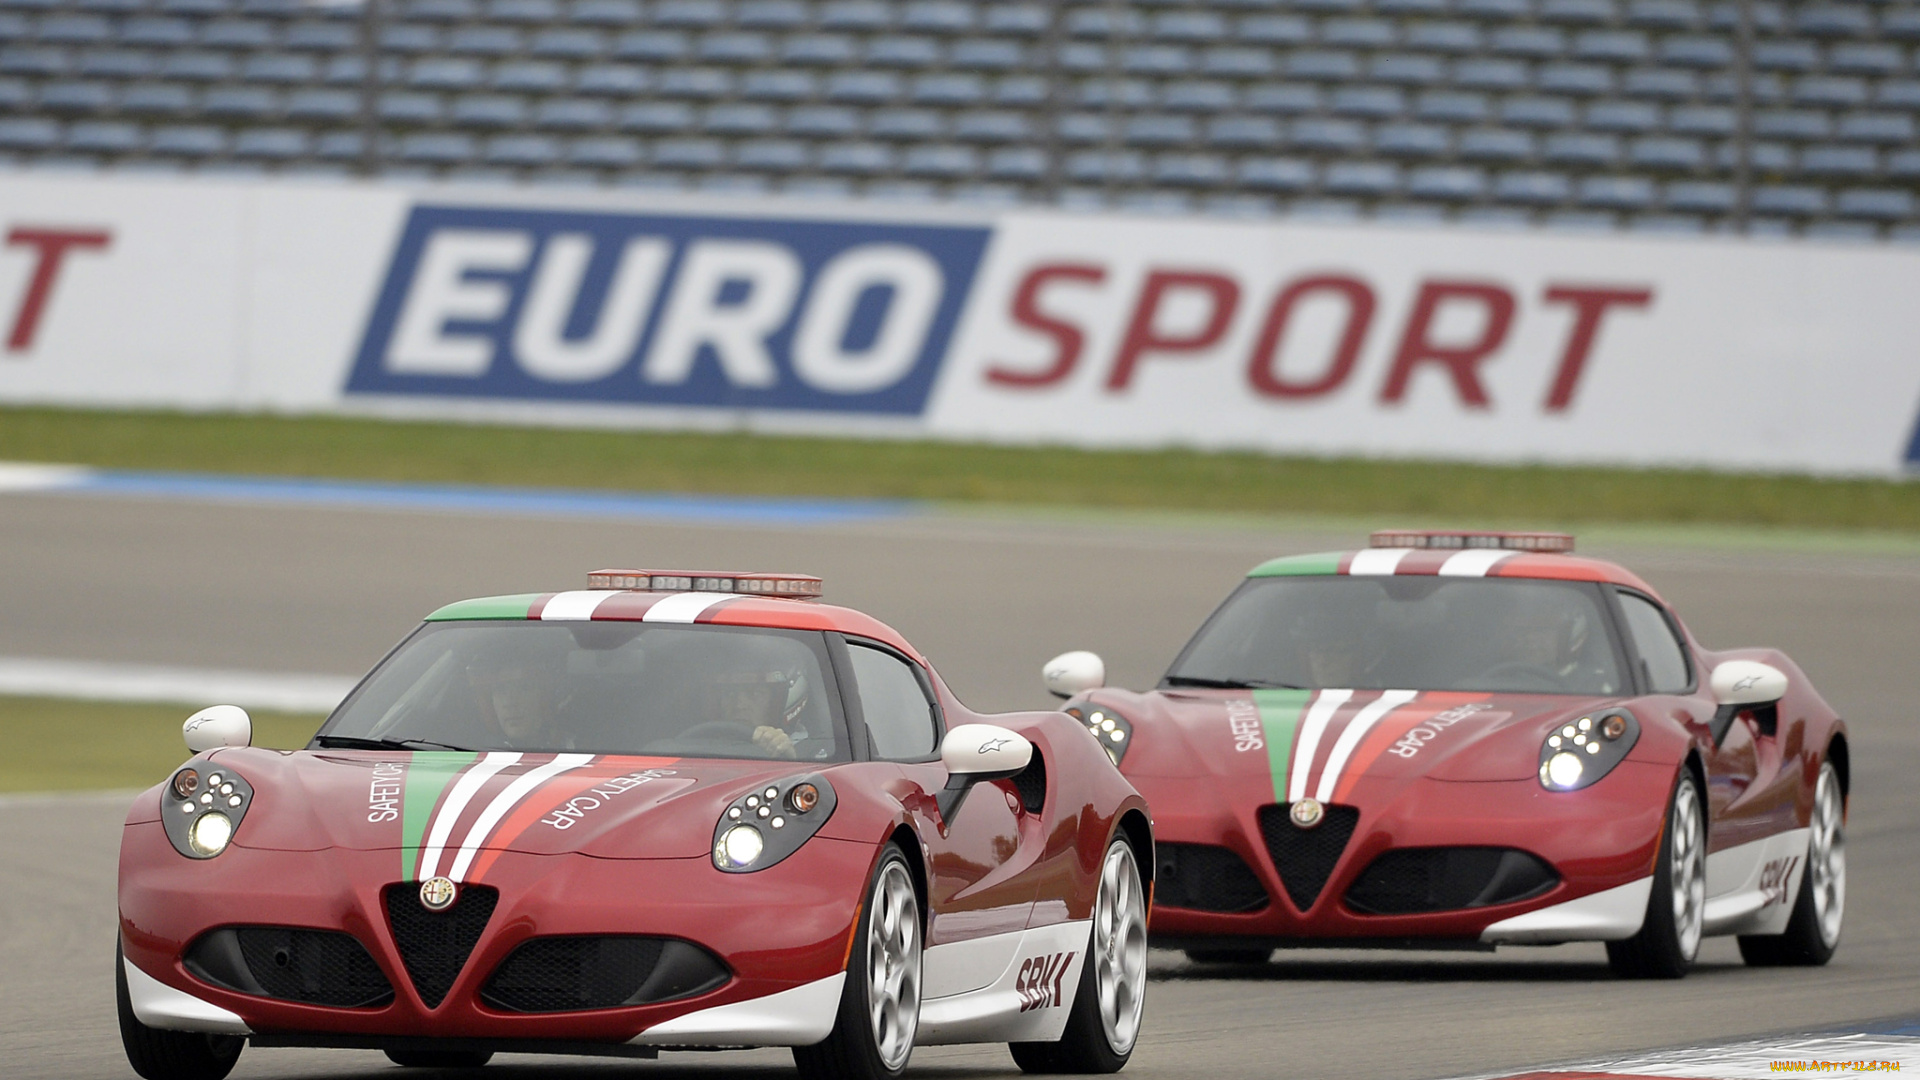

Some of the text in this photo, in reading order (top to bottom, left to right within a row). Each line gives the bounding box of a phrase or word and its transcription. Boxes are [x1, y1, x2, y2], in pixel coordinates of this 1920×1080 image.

[1387, 727, 1437, 758] CAR
[367, 776, 401, 823] SAFETY
[541, 768, 677, 830] SAFETY CAR
[1016, 952, 1075, 1013] SBK
